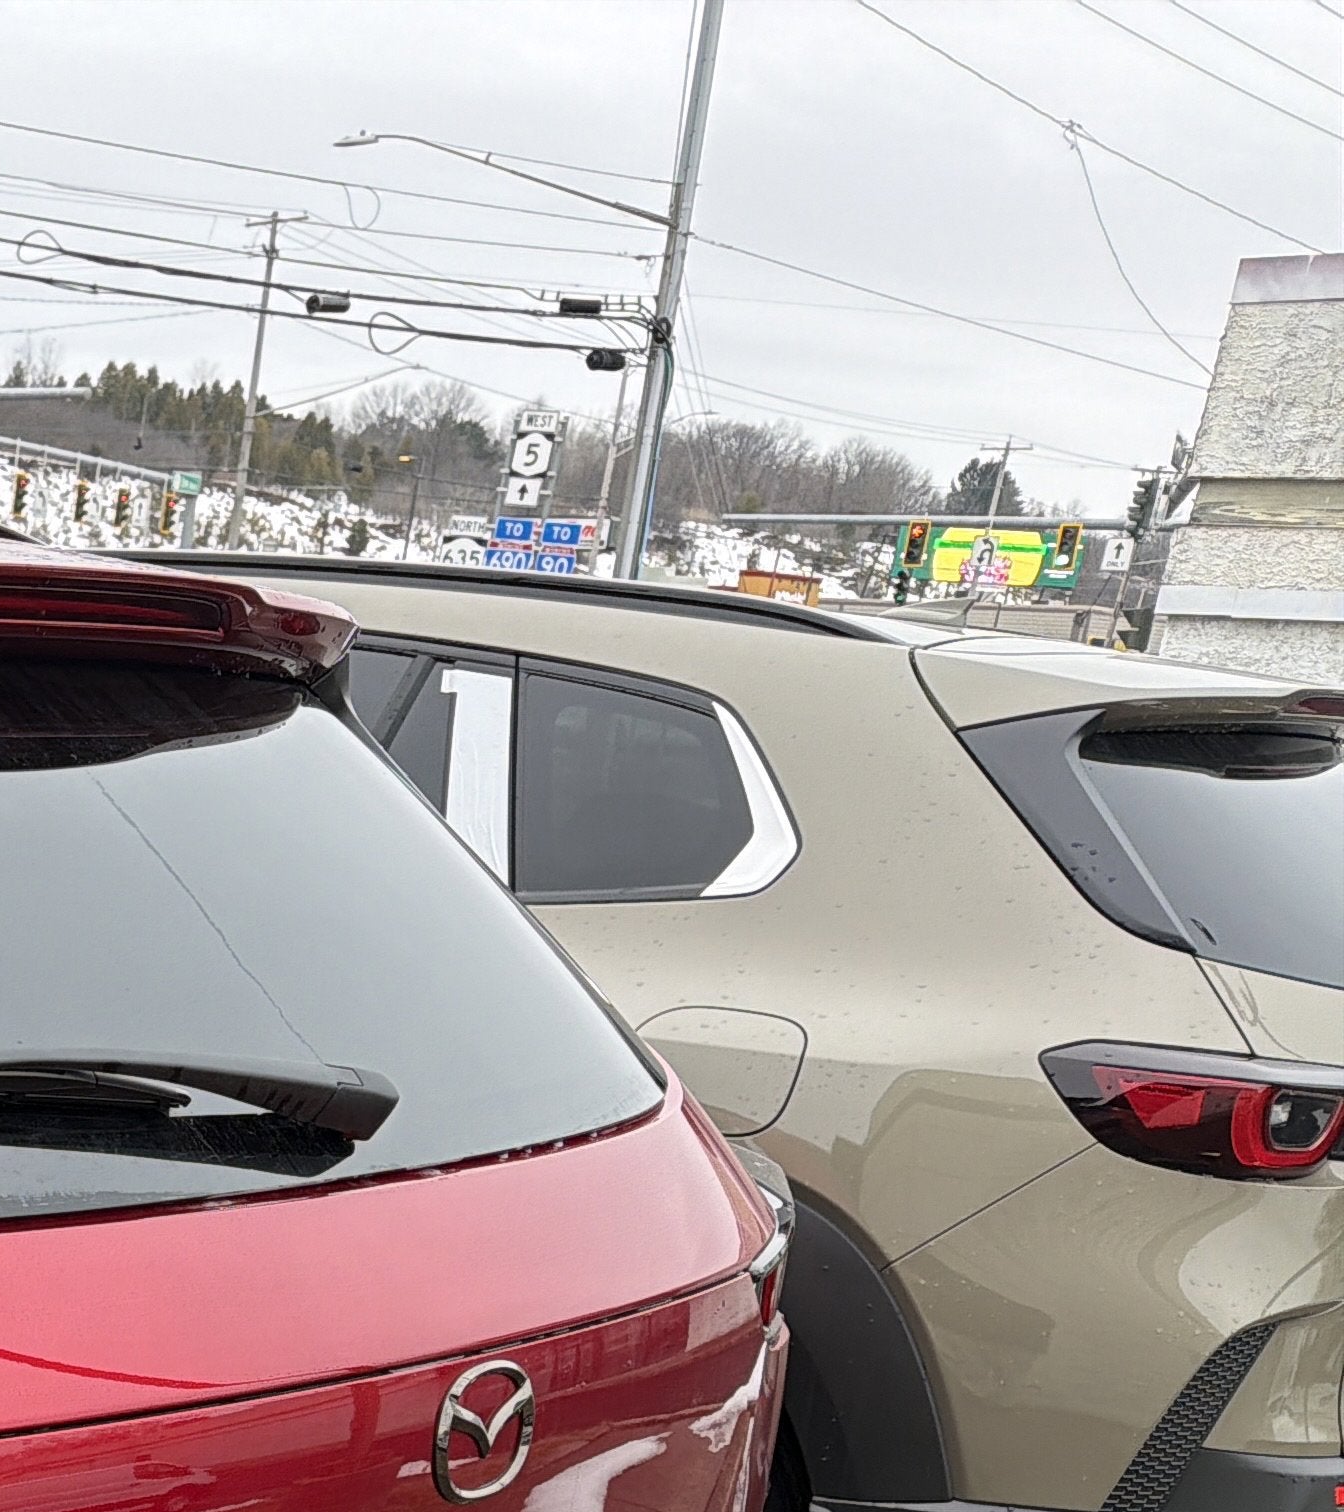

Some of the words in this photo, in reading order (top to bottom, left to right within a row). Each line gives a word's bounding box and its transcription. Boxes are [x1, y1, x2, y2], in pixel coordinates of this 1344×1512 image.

[526, 415, 554, 428] WEST
[523, 443, 541, 467] 5
[450, 519, 487, 534] NORTH
[505, 521, 524, 537] TO
[552, 525, 572, 541] TO
[442, 548, 481, 566] 635
[490, 551, 527, 570] 690
[541, 556, 569, 574] 90
